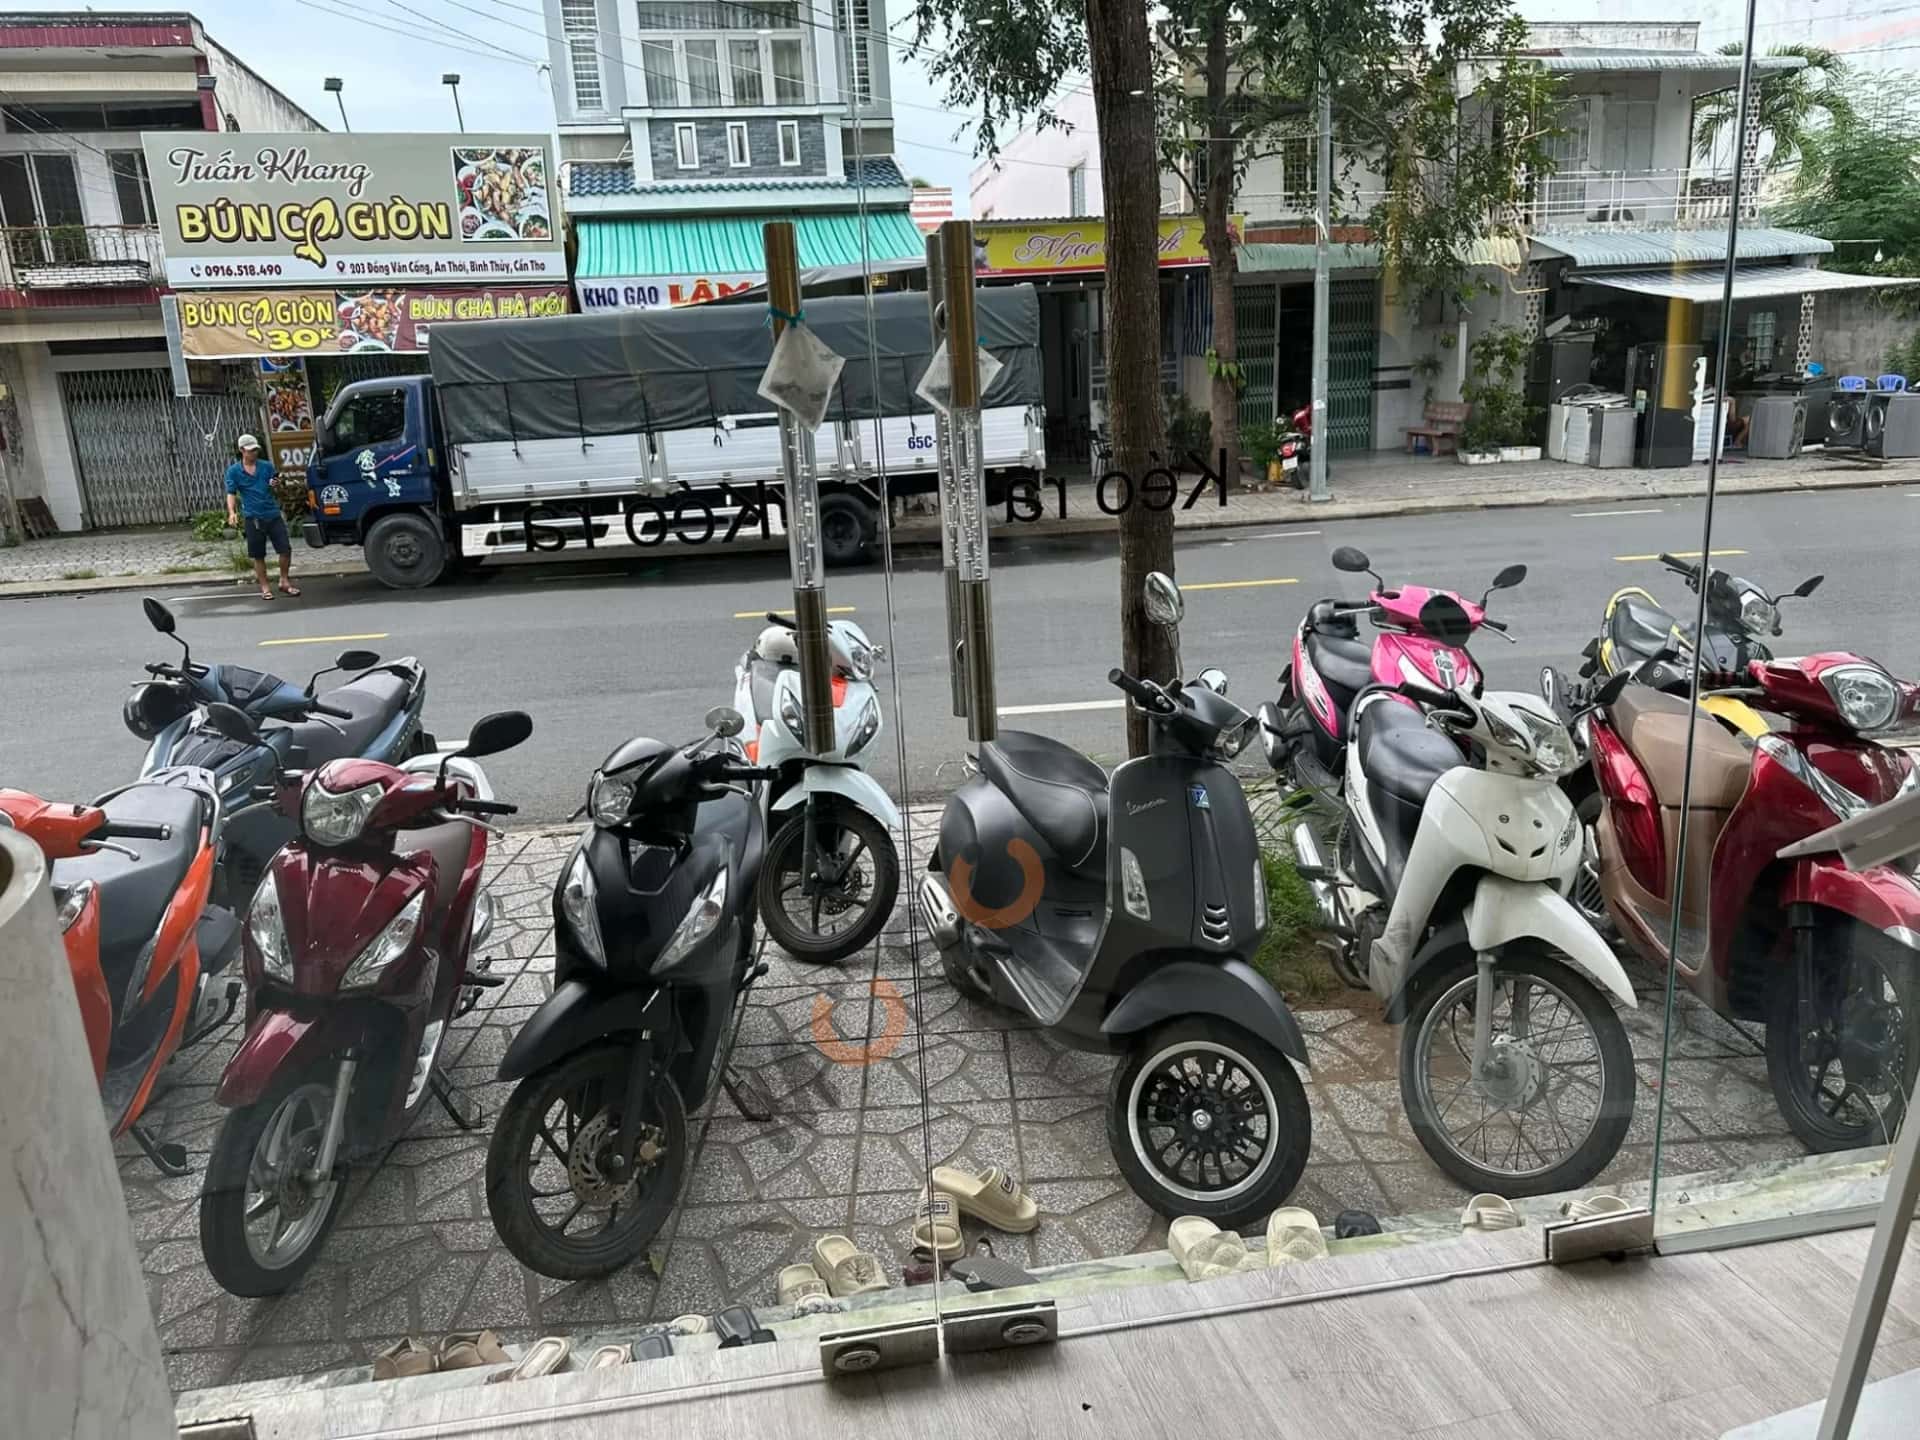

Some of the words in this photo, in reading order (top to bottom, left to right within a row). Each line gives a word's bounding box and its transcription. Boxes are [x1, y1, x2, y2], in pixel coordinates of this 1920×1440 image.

[168, 147, 256, 185] Tuấn
[256, 147, 372, 198] Khang
[176, 197, 276, 243] BÚN
[345, 195, 452, 241] GIÒN
[204, 263, 282, 277] 0916.518.490
[349, 262, 366, 274] 203
[434, 260, 447, 273] An
[183, 298, 236, 327] BÚN
[275, 296, 335, 327] GIÒN
[410, 294, 452, 320] BÚN
[497, 291, 528, 318] HÀ
[582, 286, 618, 307] KHO
[624, 285, 660, 310] GẠO
